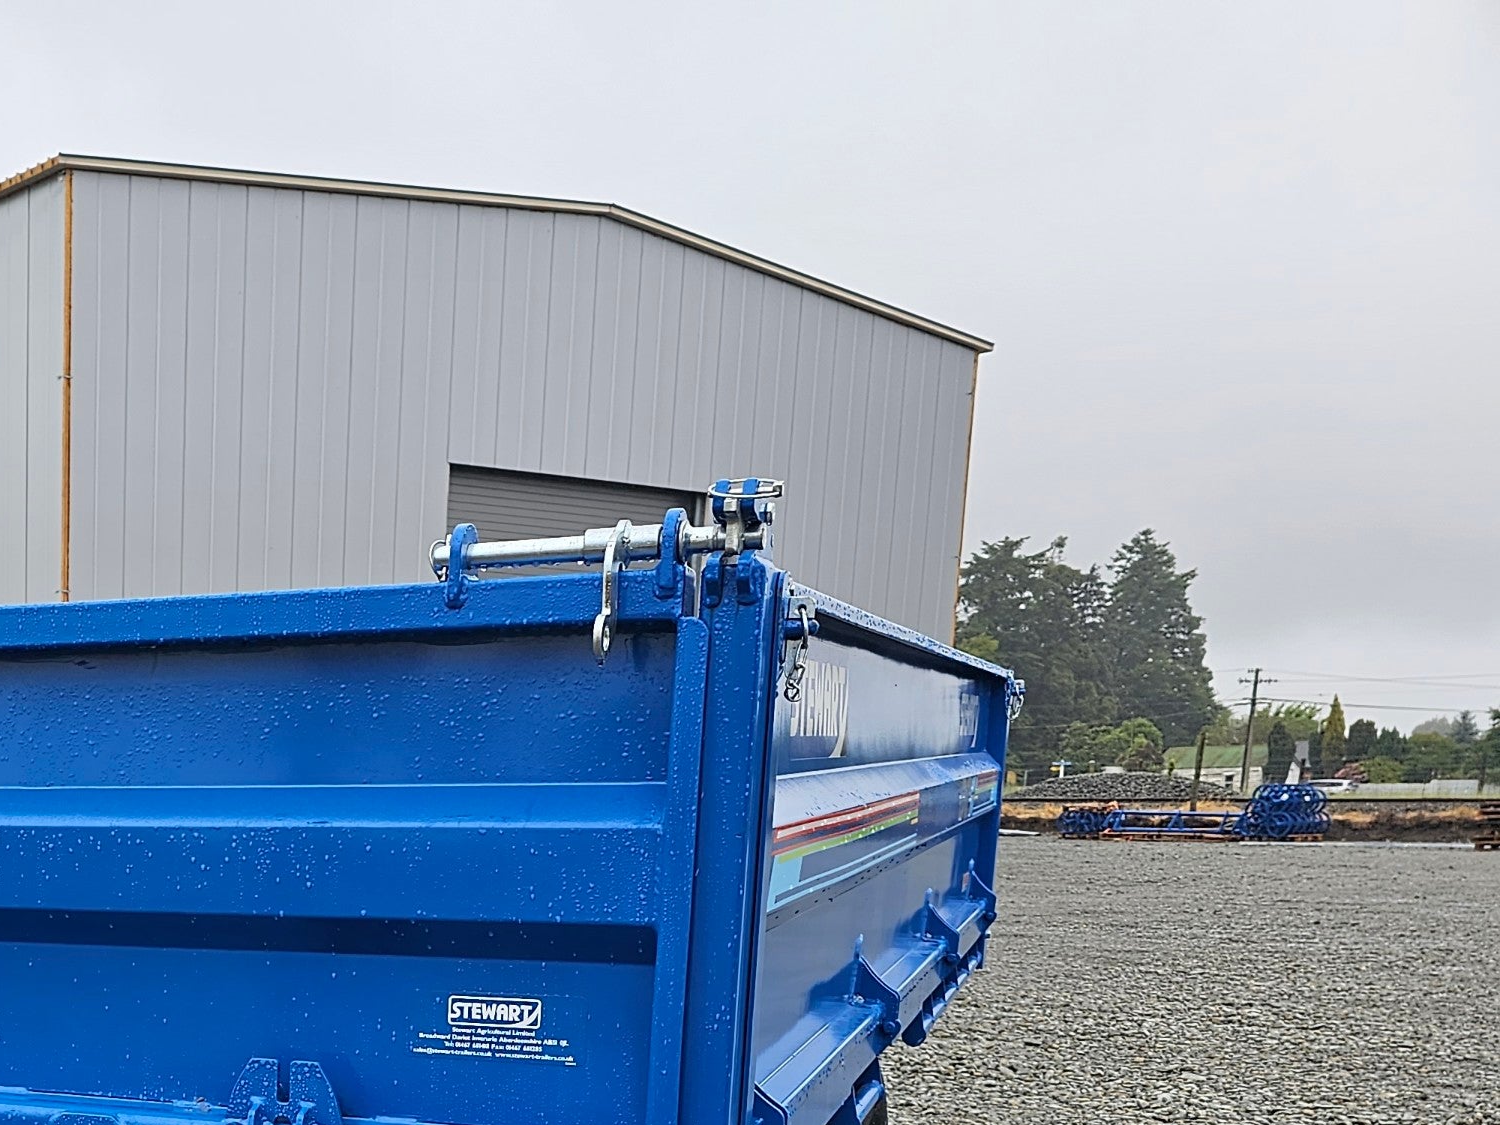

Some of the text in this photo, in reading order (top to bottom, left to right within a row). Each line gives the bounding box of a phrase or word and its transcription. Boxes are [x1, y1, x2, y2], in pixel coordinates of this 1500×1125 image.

[450, 1002, 540, 1027] STEWART
[452, 1026, 535, 1037] Stewart Agricultural Limited
